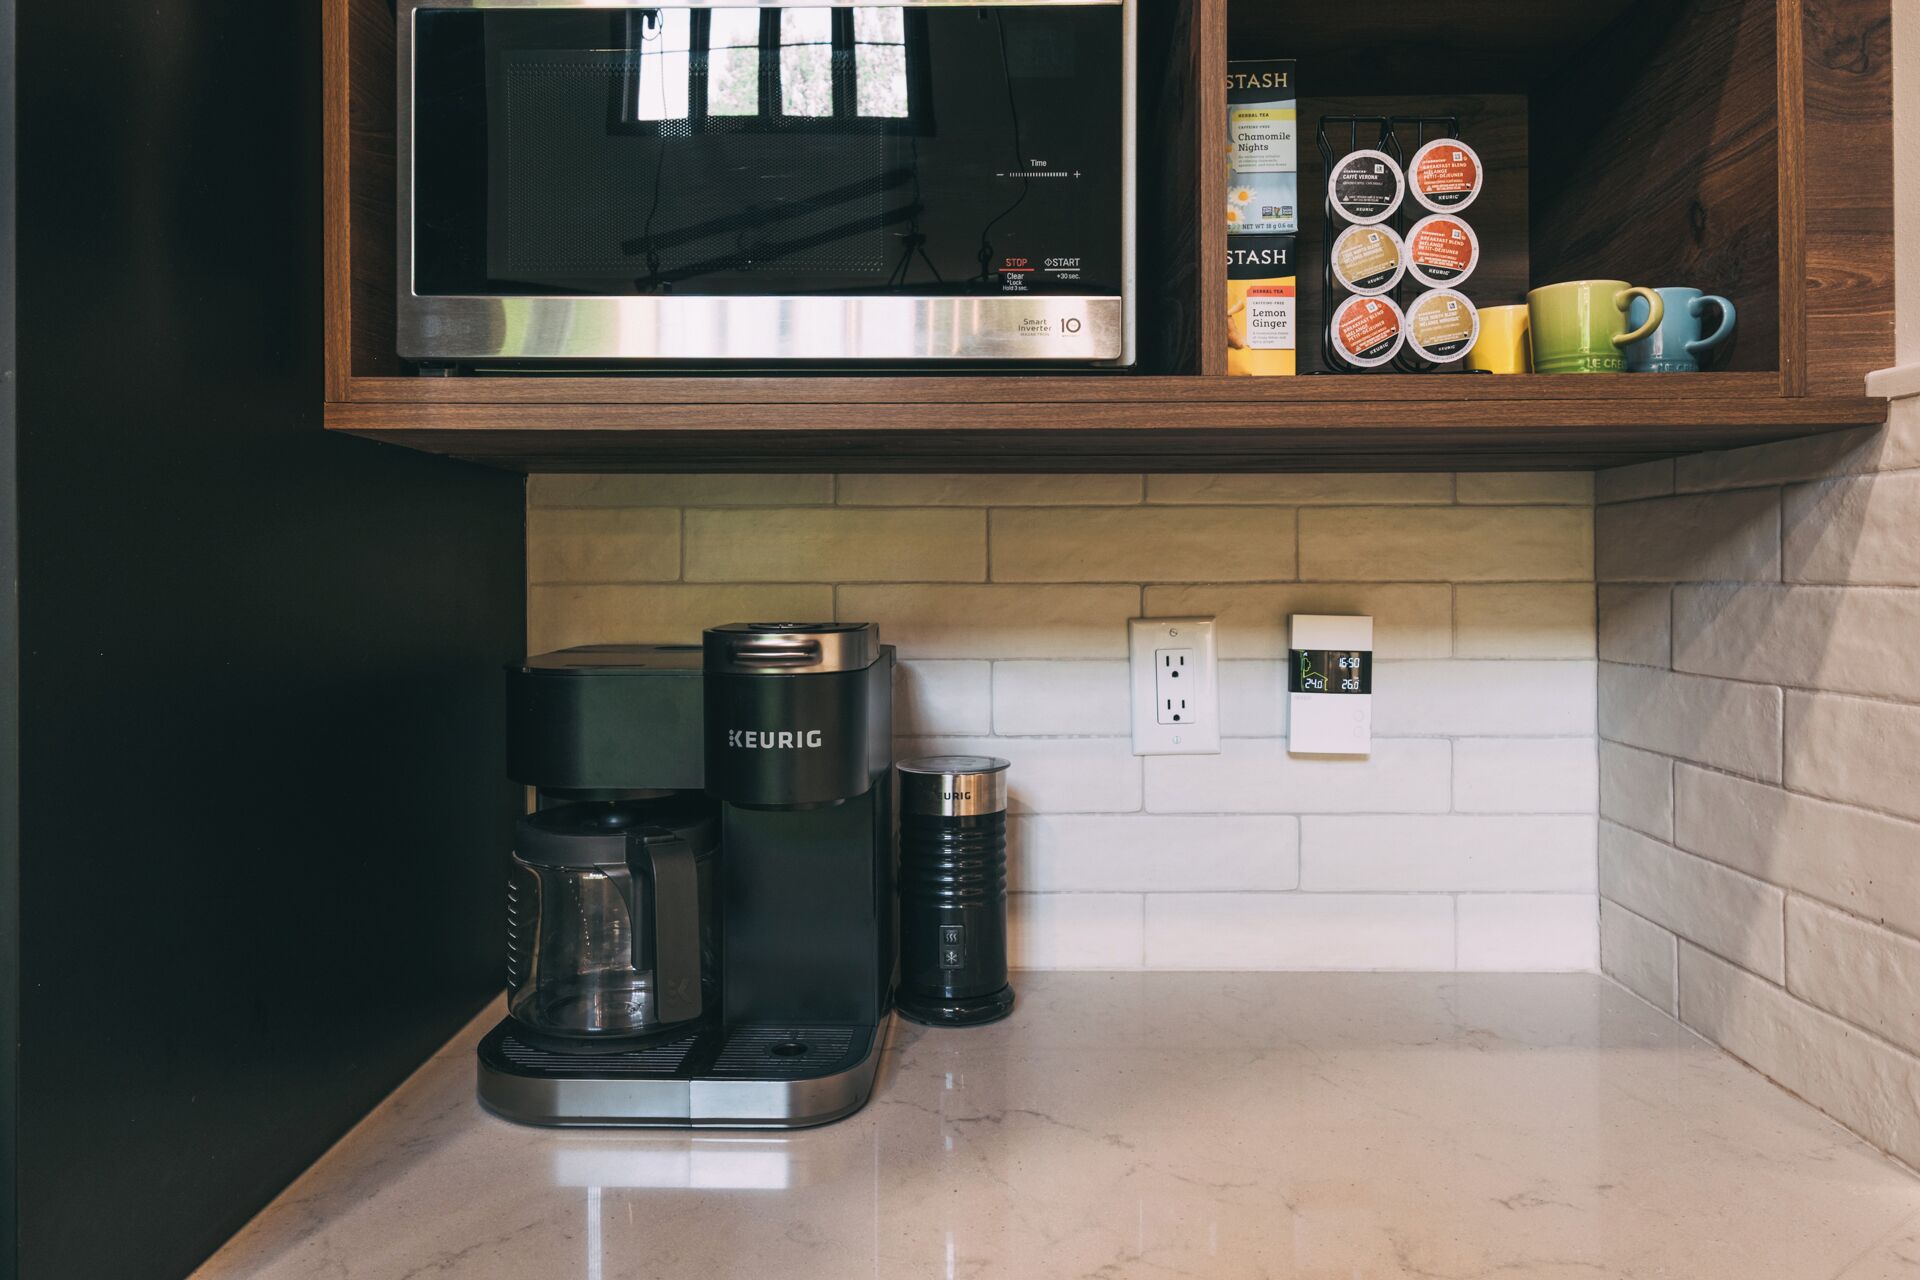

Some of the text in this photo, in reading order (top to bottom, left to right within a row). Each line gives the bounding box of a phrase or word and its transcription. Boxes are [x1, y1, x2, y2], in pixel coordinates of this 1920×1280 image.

[1227, 72, 1288, 89] STASH
[1238, 132, 1291, 141] Chamomile
[1238, 144, 1269, 153] Nights
[1030, 159, 1047, 167] Time
[1227, 249, 1287, 265] STASH
[1005, 258, 1028, 267] STOP
[1052, 258, 1080, 267] START
[1252, 308, 1286, 317] Lemon
[1061, 318, 1081, 333] 10
[1252, 319, 1287, 329] Ginger
[1587, 359, 1600, 368] LE
[1339, 657, 1360, 668] 16:50
[729, 729, 822, 749] KEURIG
[938, 792, 971, 800] EURIG
